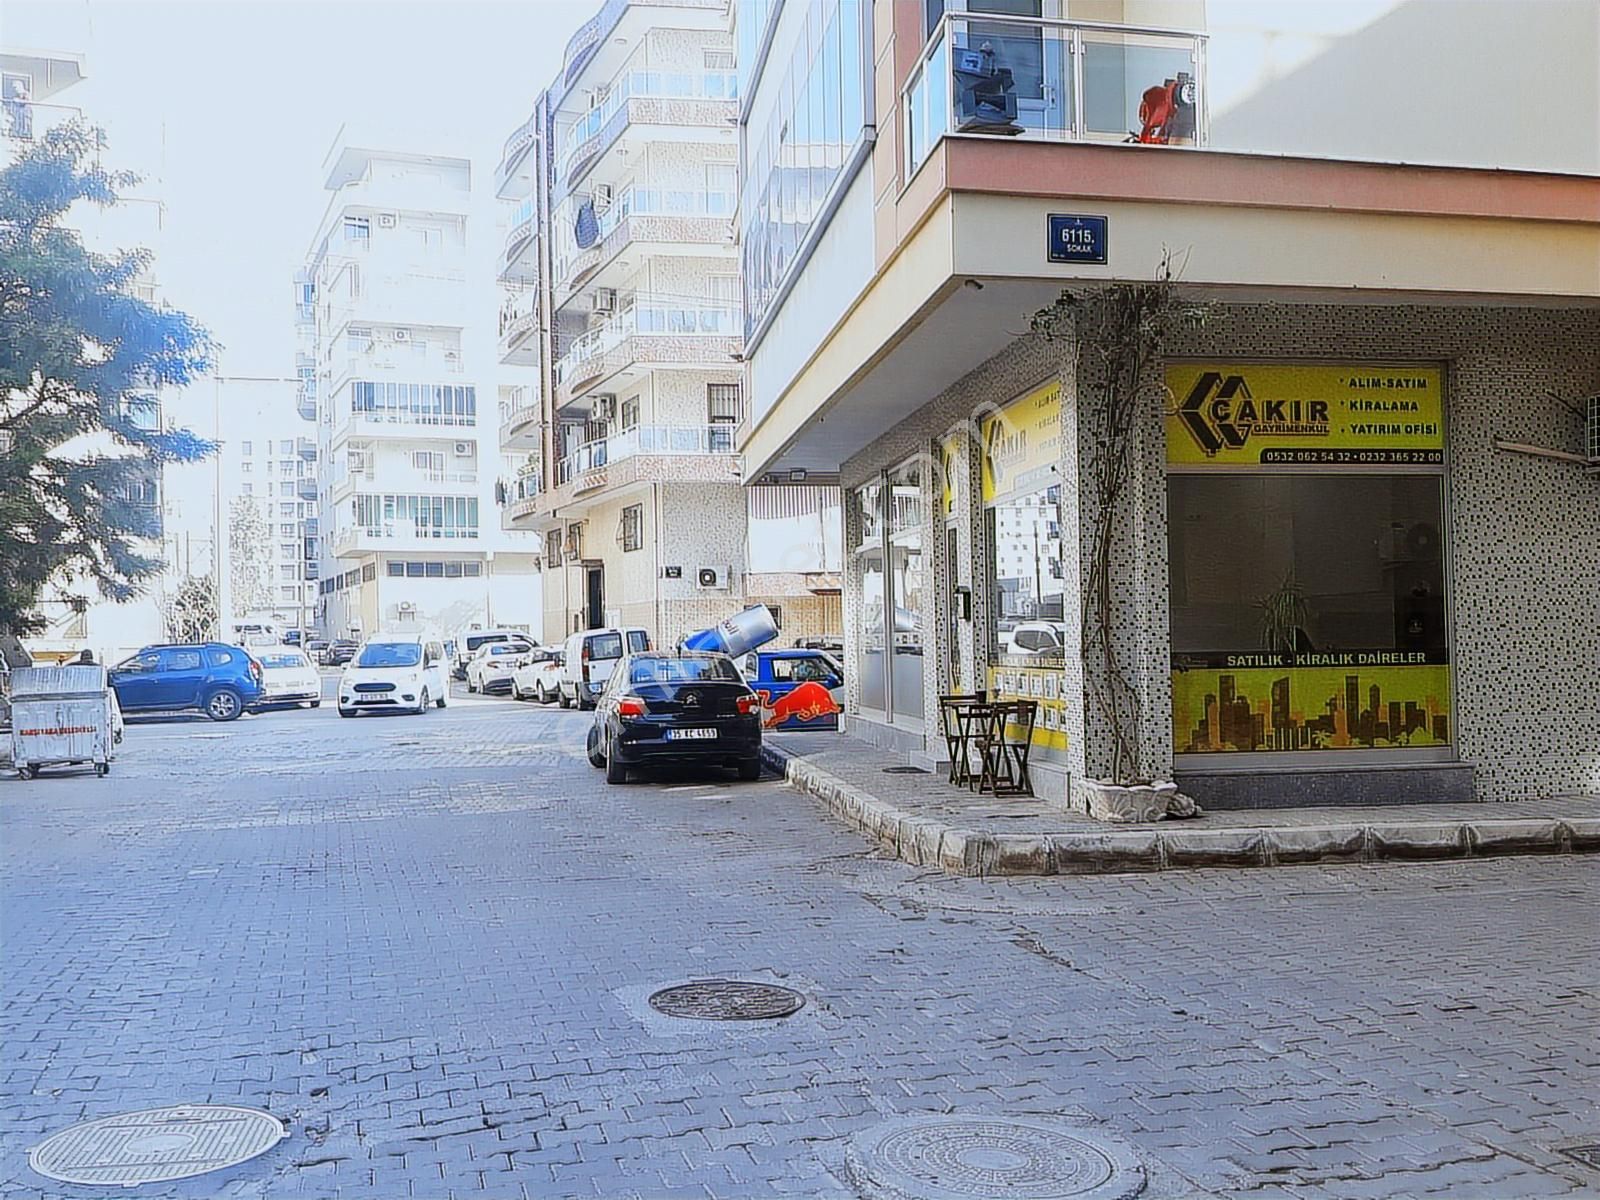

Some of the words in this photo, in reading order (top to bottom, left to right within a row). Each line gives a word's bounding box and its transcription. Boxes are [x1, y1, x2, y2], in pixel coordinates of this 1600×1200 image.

[1062, 228, 1095, 244] 6115.
[1067, 244, 1093, 253] SOKAK
[1349, 377, 1427, 389] ALIM-SATIM
[1211, 400, 1329, 423] ÇAKIR
[1349, 398, 1419, 412] KİRALAMA
[1350, 423, 1401, 435] YATIRIM
[1404, 422, 1437, 435] OFİSİ
[1267, 451, 1294, 461] 0532
[1297, 451, 1318, 461] 062
[1320, 452, 1334, 462] 54
[1337, 452, 1351, 462] 32
[1359, 452, 1386, 462] 0232
[1390, 452, 1409, 462] 365
[1412, 452, 1425, 462] 22
[1428, 452, 1441, 462] 00
[1227, 654, 1283, 667] SATILIK
[1296, 652, 1354, 665] KİRALIK
[1358, 650, 1426, 664] DAİRELER
